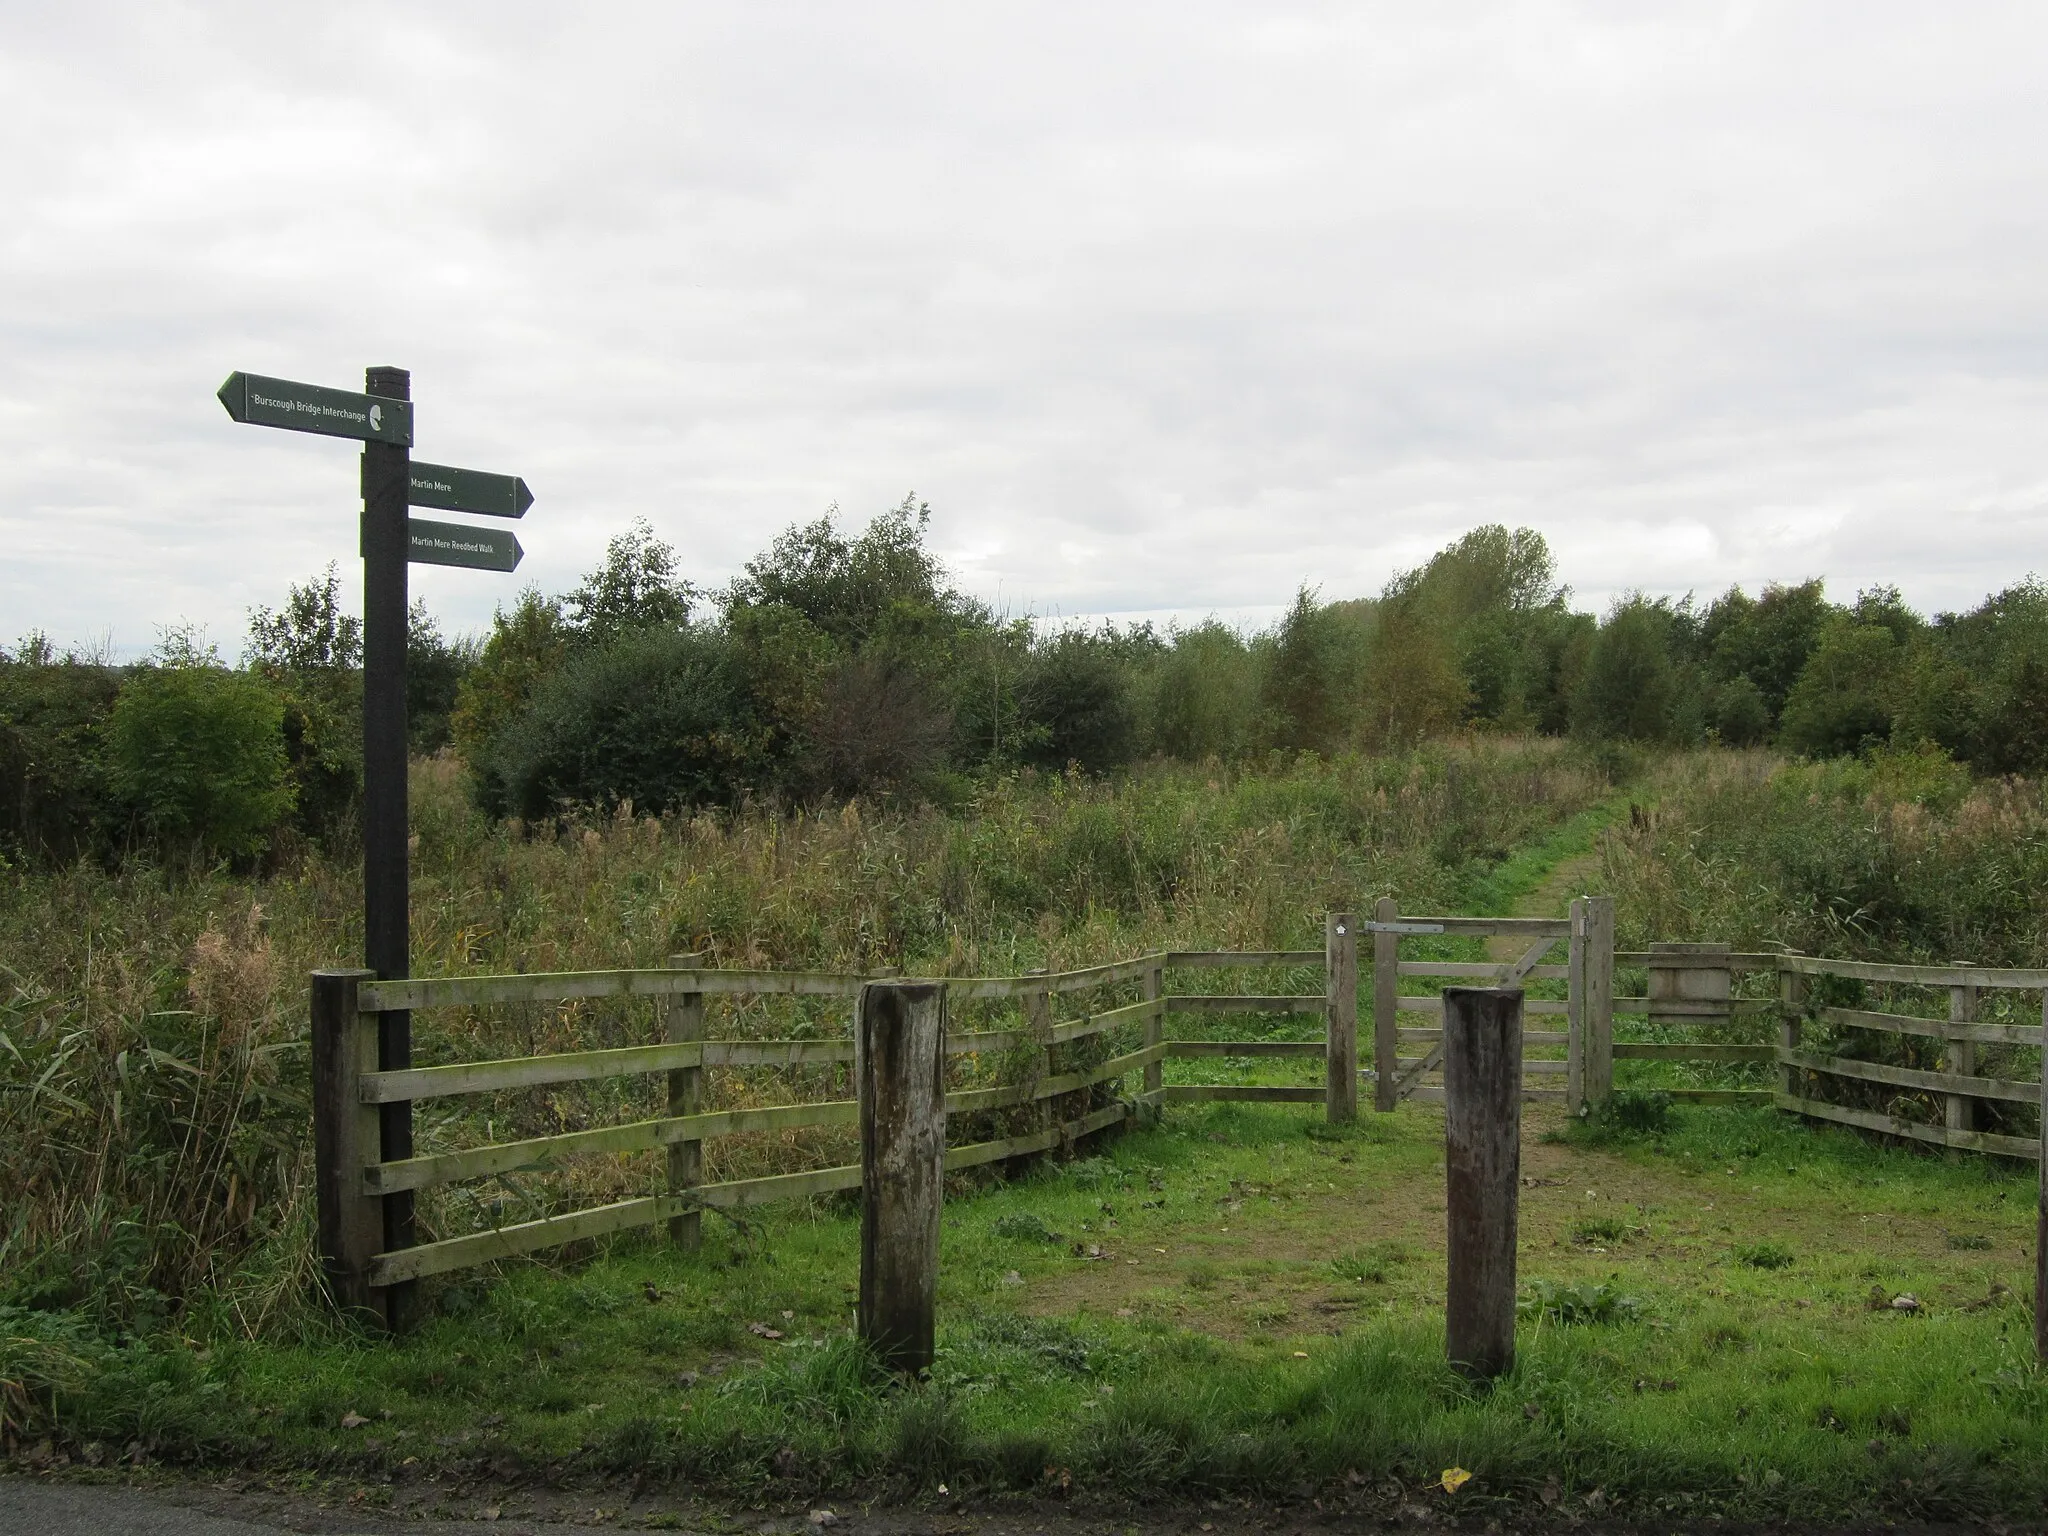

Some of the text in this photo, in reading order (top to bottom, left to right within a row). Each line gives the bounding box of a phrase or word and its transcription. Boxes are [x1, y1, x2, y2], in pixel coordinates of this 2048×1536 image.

[254, 394, 366, 422] Burscough Bridge Interchange
[410, 477, 452, 492] Martin Mere
[411, 535, 494, 554] Martin Mere Reedbed Walk
